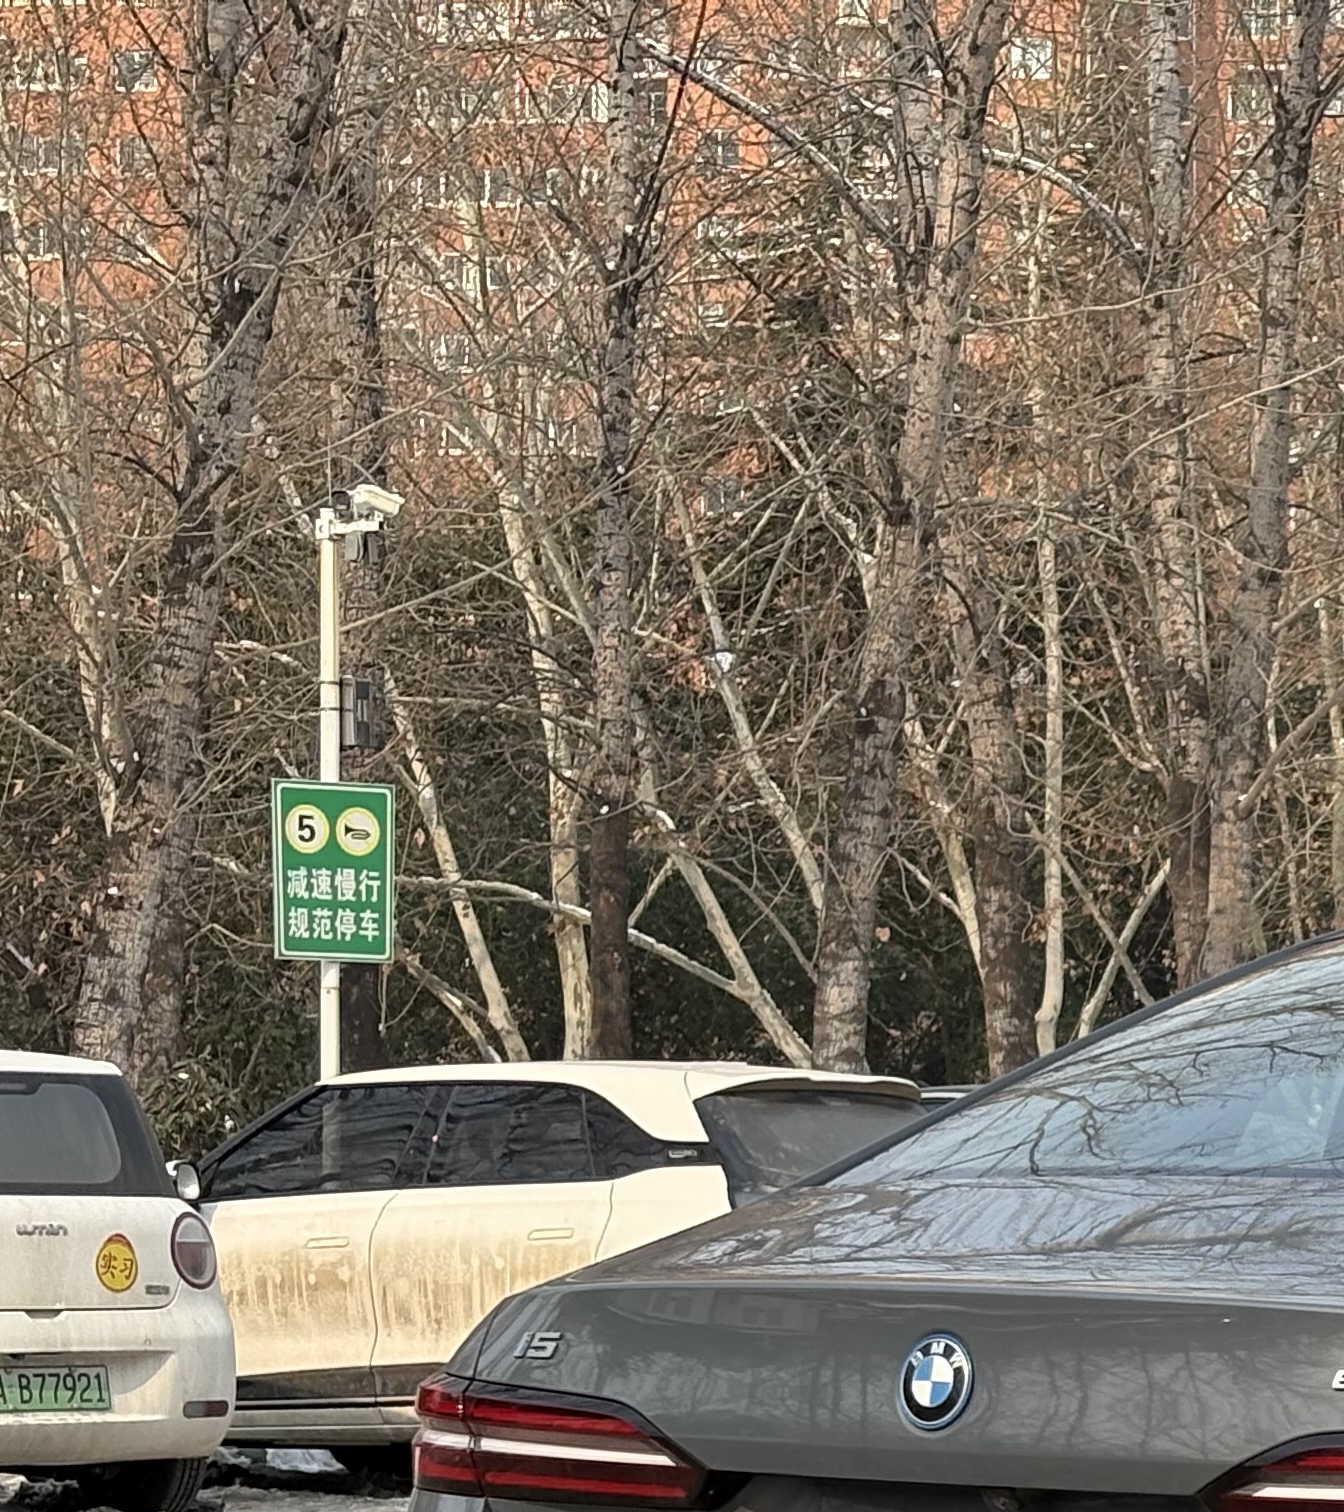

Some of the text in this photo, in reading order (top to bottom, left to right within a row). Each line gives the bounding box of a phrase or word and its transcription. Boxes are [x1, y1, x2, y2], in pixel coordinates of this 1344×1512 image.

[298, 814, 316, 843] 5
[286, 866, 382, 903] 减速慢行
[287, 906, 381, 942] 规范停车
[100, 1251, 134, 1280] 实习
[909, 1340, 965, 1370] BMW
[17, 1372, 106, 1404] B77921
